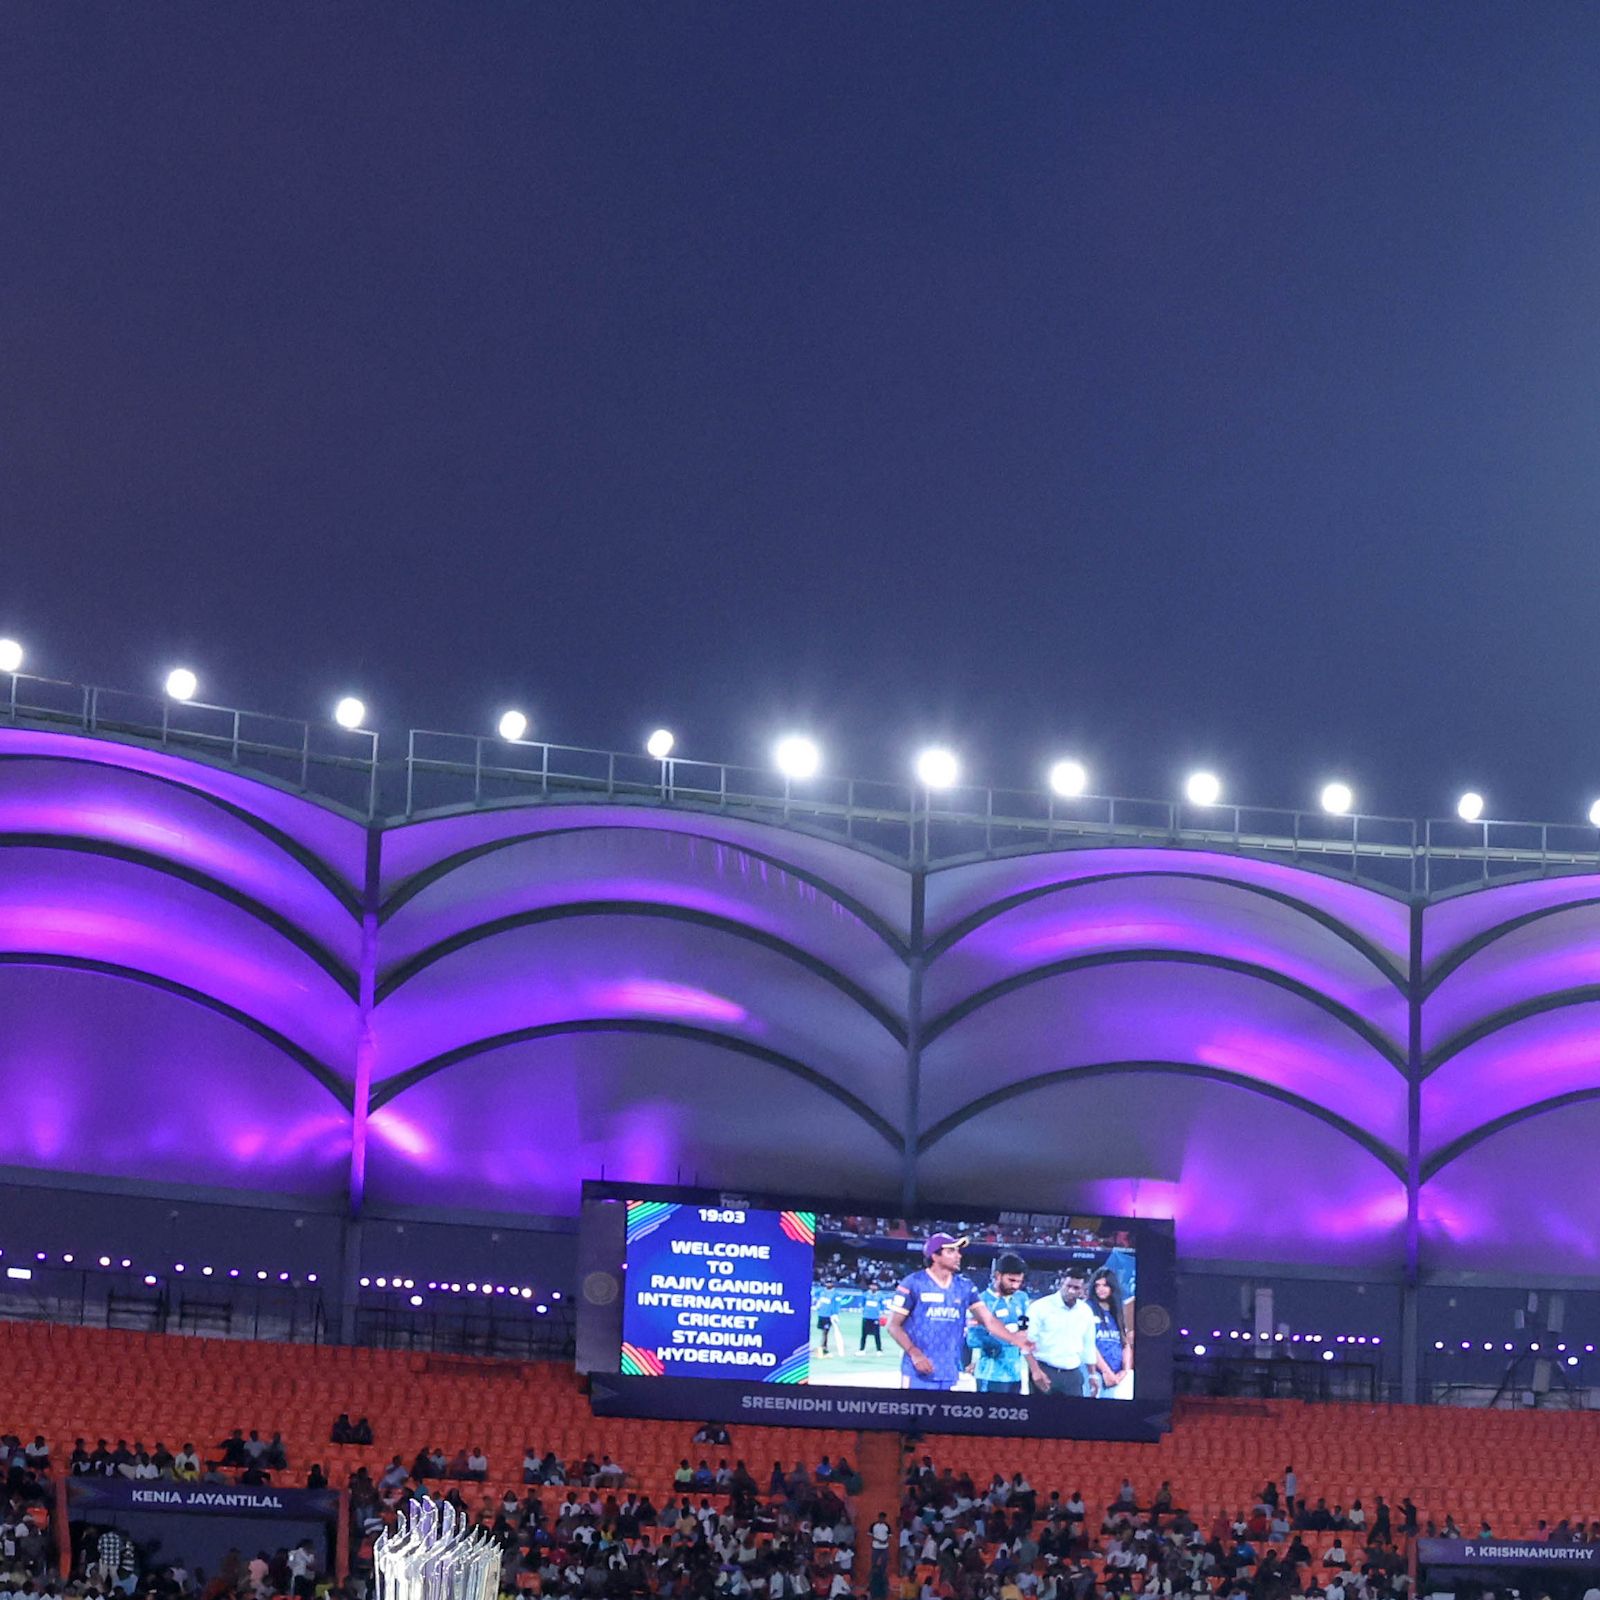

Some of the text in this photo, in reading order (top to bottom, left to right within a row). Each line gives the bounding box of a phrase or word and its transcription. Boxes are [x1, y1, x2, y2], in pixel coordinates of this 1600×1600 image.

[698, 1208, 746, 1224] 19:03
[671, 1240, 770, 1259] WELCOME
[706, 1260, 734, 1274] TO
[651, 1275, 783, 1296] RAJIV GANDHI
[638, 1291, 795, 1314] INTERNATIONAL
[677, 1312, 759, 1329] CRICKET
[672, 1330, 762, 1348] STADIUM
[657, 1347, 777, 1367] HYDERABAD
[741, 1395, 1029, 1421] SREENIDHI UNIVERSITY TG20 2026
[132, 1490, 283, 1508] KENIA JAYANTILAL
[1465, 1546, 1594, 1559] P. KRISHNAMURTHY
